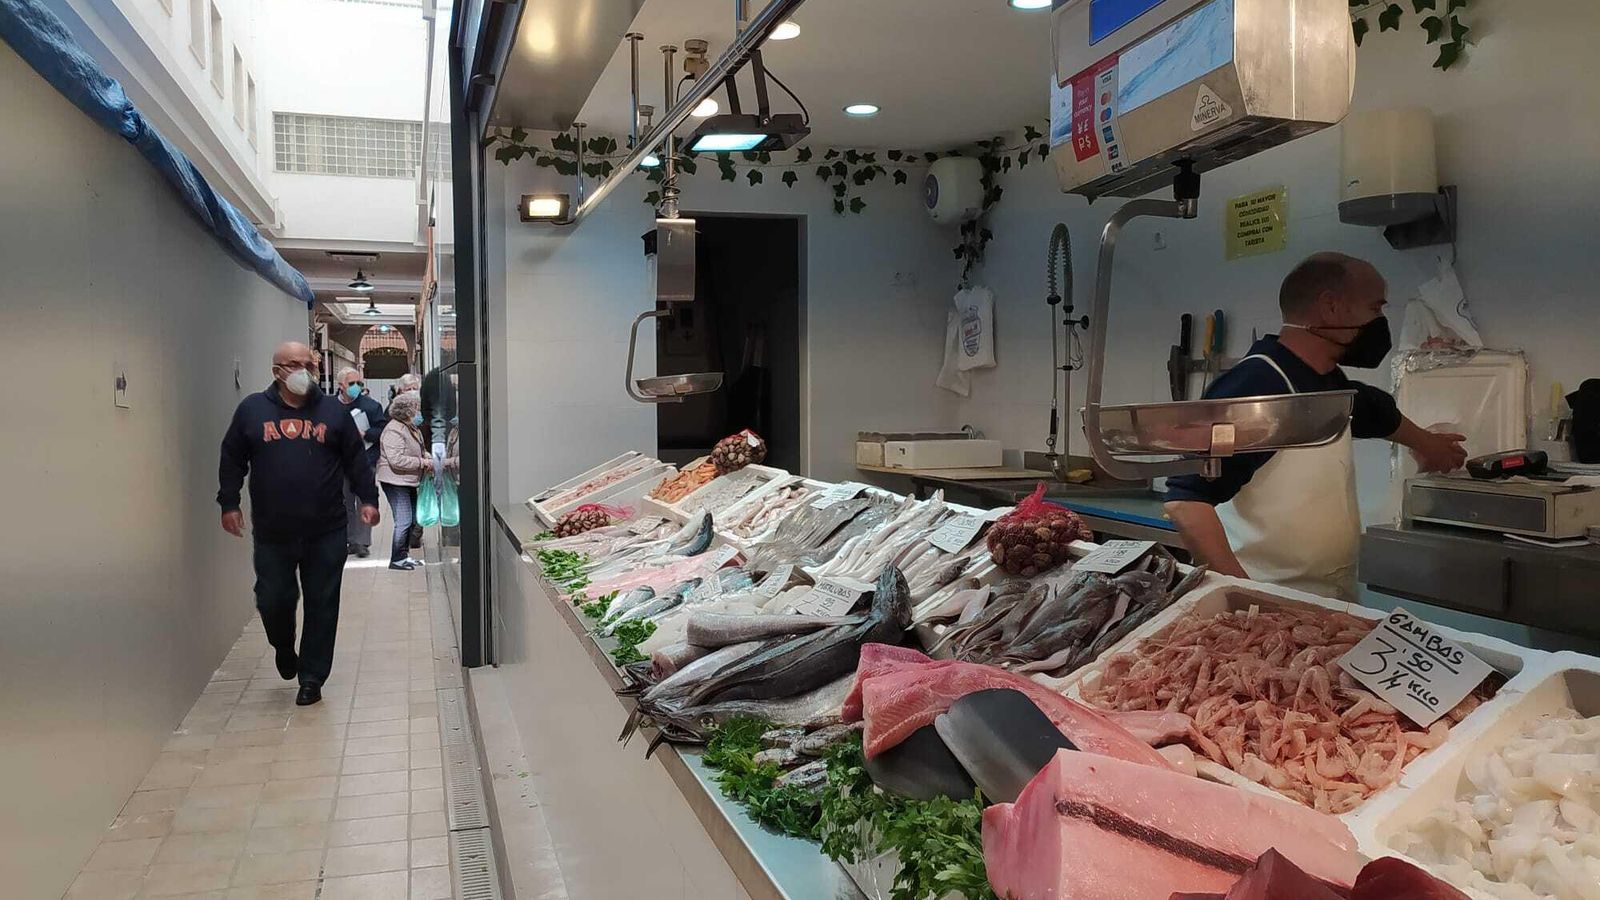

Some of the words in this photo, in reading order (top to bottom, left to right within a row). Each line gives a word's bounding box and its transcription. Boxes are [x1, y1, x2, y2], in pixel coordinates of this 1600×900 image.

[1194, 103, 1226, 123] MINERVA
[1389, 613, 1464, 666] GAMBAS
[1407, 680, 1440, 707] KILO
